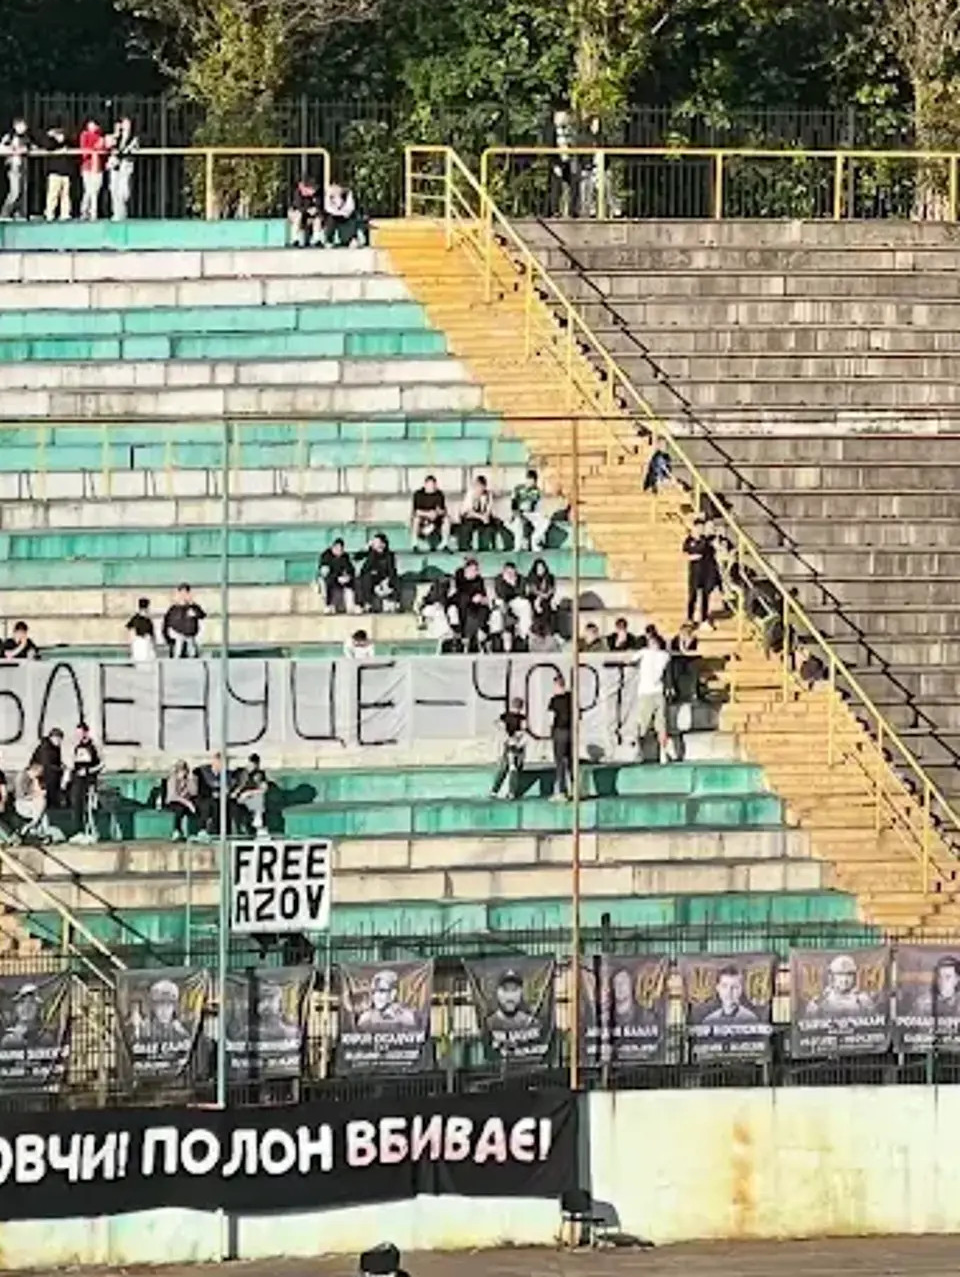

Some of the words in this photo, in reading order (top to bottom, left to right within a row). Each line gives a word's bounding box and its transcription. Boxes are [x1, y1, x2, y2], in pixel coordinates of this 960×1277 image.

[234, 843, 327, 885] FREE
[236, 885, 324, 922] AZOV
[141, 1124, 333, 1178] ПОЛОН
[345, 1114, 551, 1167] ВБИВАЄ!
